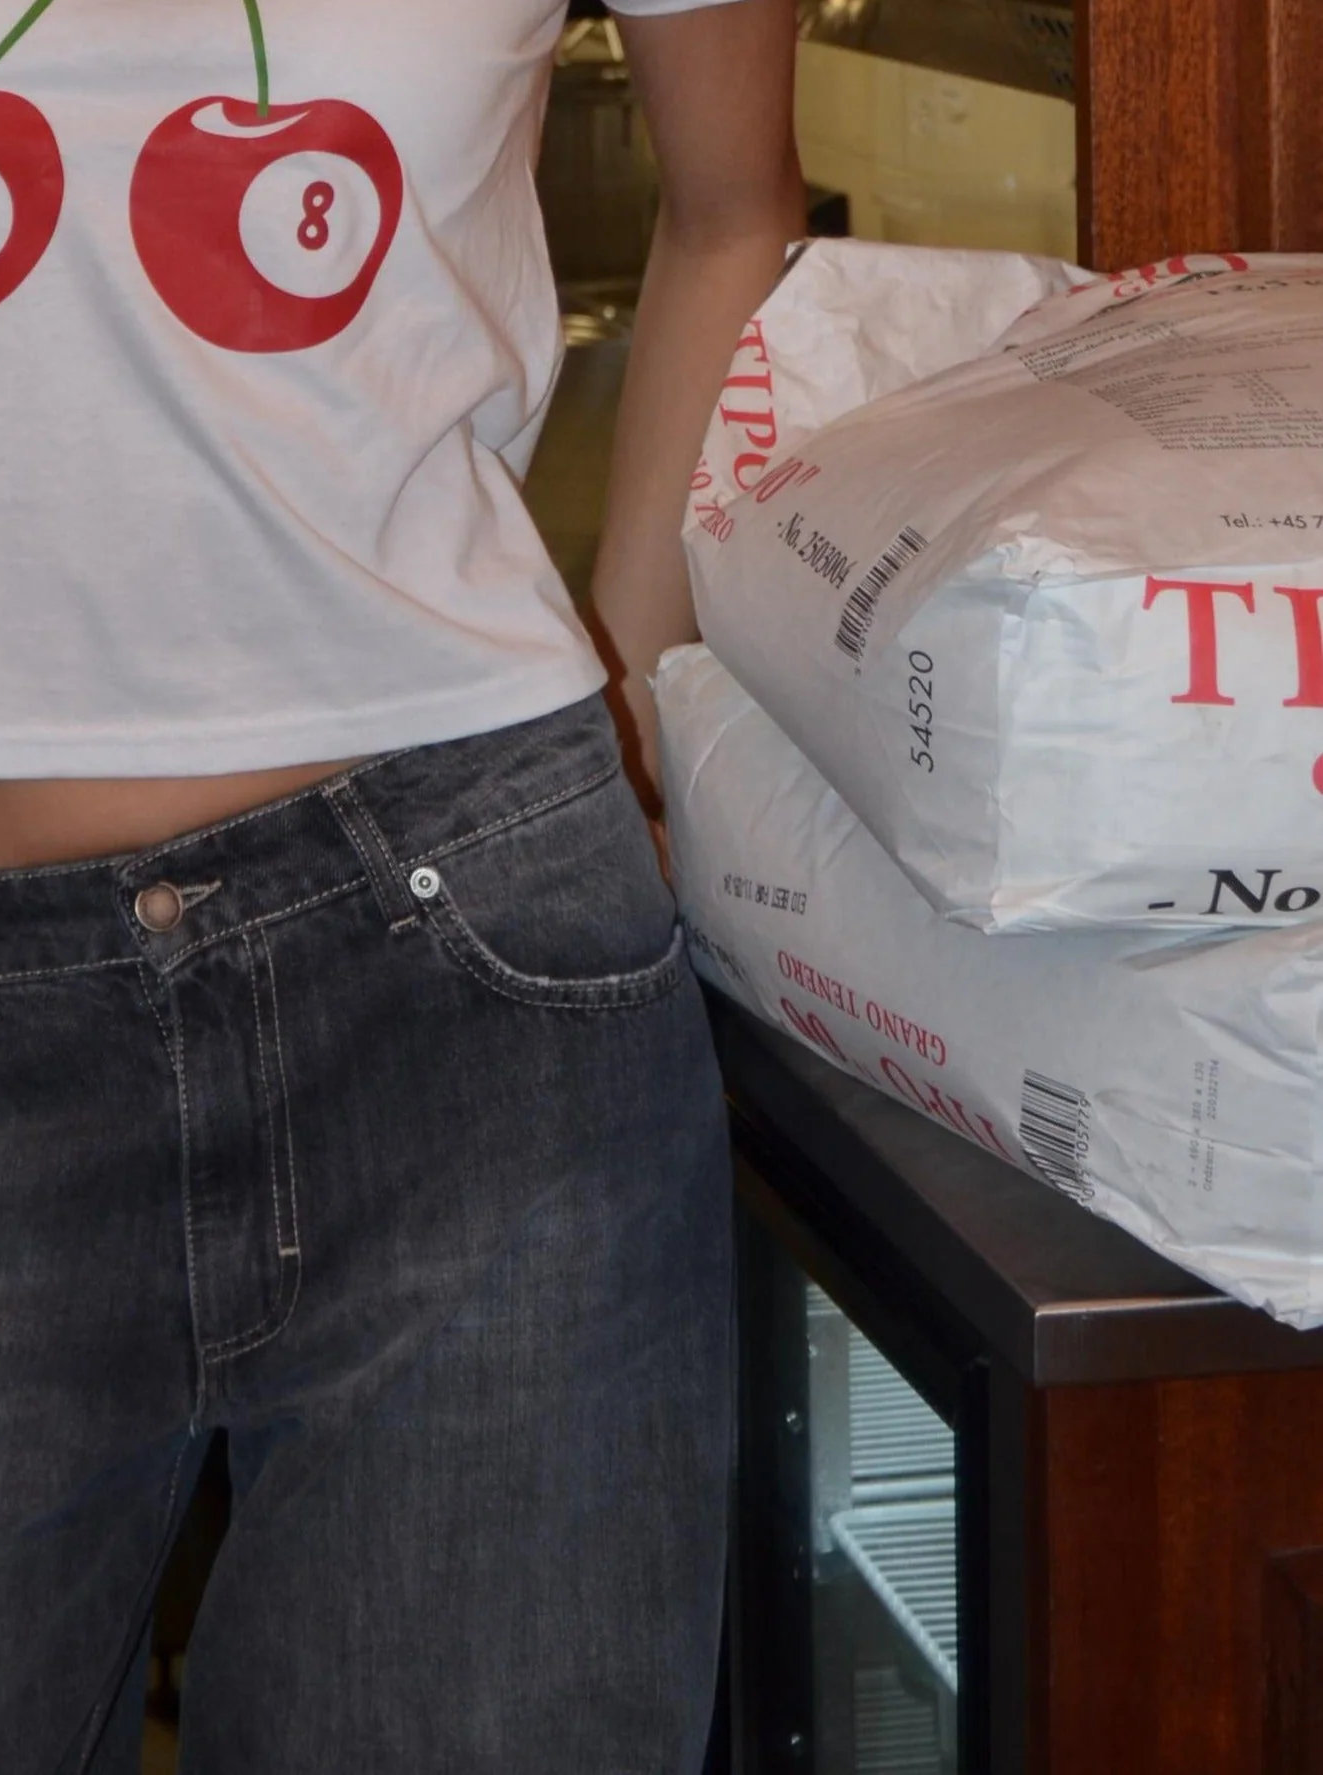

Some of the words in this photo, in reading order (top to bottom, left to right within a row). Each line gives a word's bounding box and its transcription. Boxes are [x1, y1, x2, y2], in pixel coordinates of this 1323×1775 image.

[297, 181, 334, 251] 8
[1268, 514, 1308, 530] +45
[910, 650, 933, 772] 54520
[777, 949, 860, 1020] TENERO
[866, 1000, 946, 1067] GRANO
[1075, 1098, 1092, 1161] 105779
